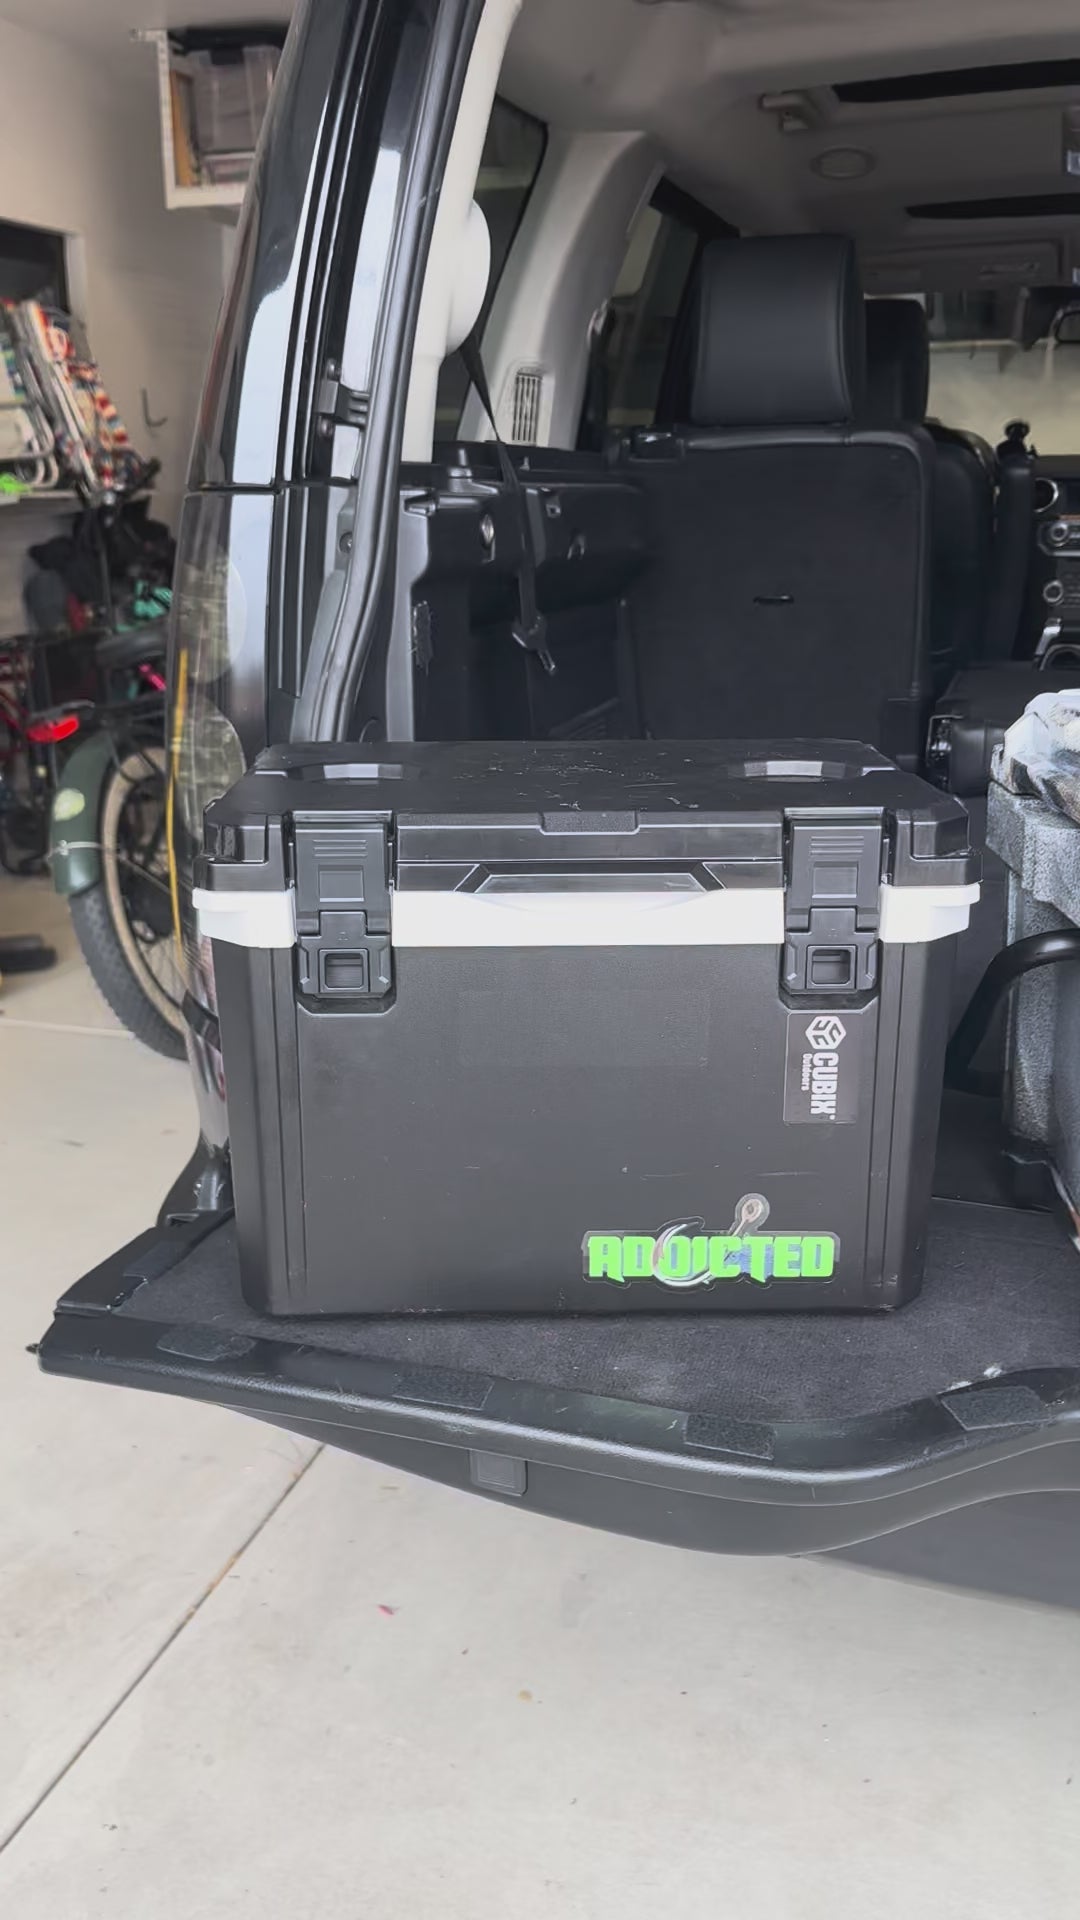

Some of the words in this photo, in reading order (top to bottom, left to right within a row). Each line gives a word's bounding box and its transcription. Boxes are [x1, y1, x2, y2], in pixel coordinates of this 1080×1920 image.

[801, 1053, 813, 1091] Outdoors
[810, 1052, 839, 1115] CUBIX
[588, 1236, 835, 1284] ADDICTED
